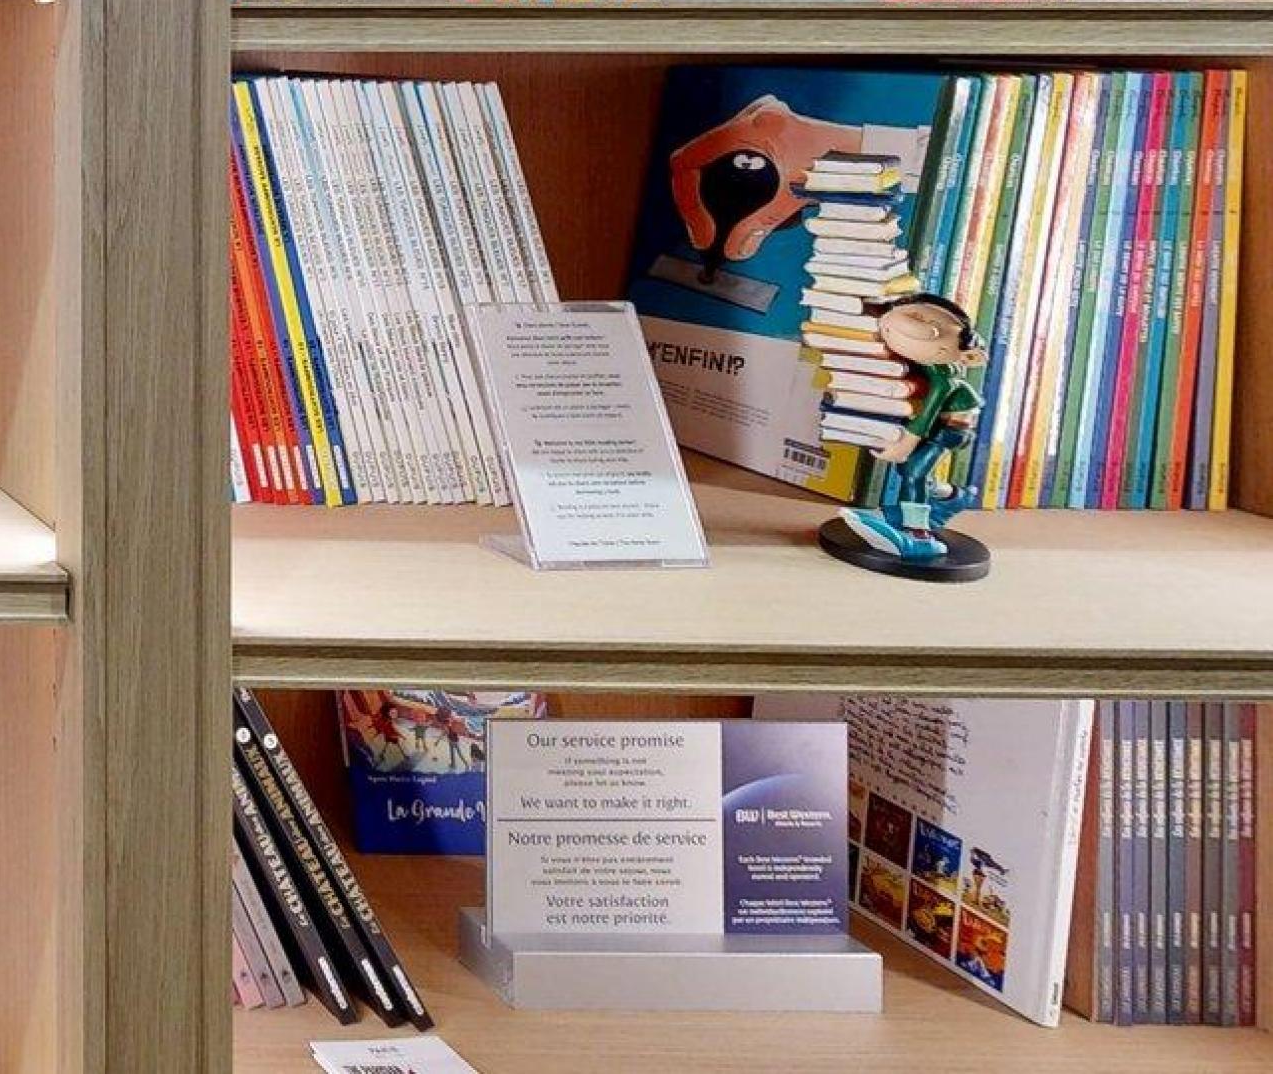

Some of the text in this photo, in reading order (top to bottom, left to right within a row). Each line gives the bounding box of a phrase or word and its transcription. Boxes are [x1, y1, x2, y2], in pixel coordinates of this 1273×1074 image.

[527, 733, 685, 750] Our service promise
[387, 798, 406, 821] La
[411, 798, 475, 825] Grande
[521, 796, 691, 811] We want to make it right.
[508, 831, 707, 848] Notre promesse de service
[546, 894, 669, 907] Votre satisfaction
[547, 913, 567, 924] est
[572, 913, 610, 924] notre
